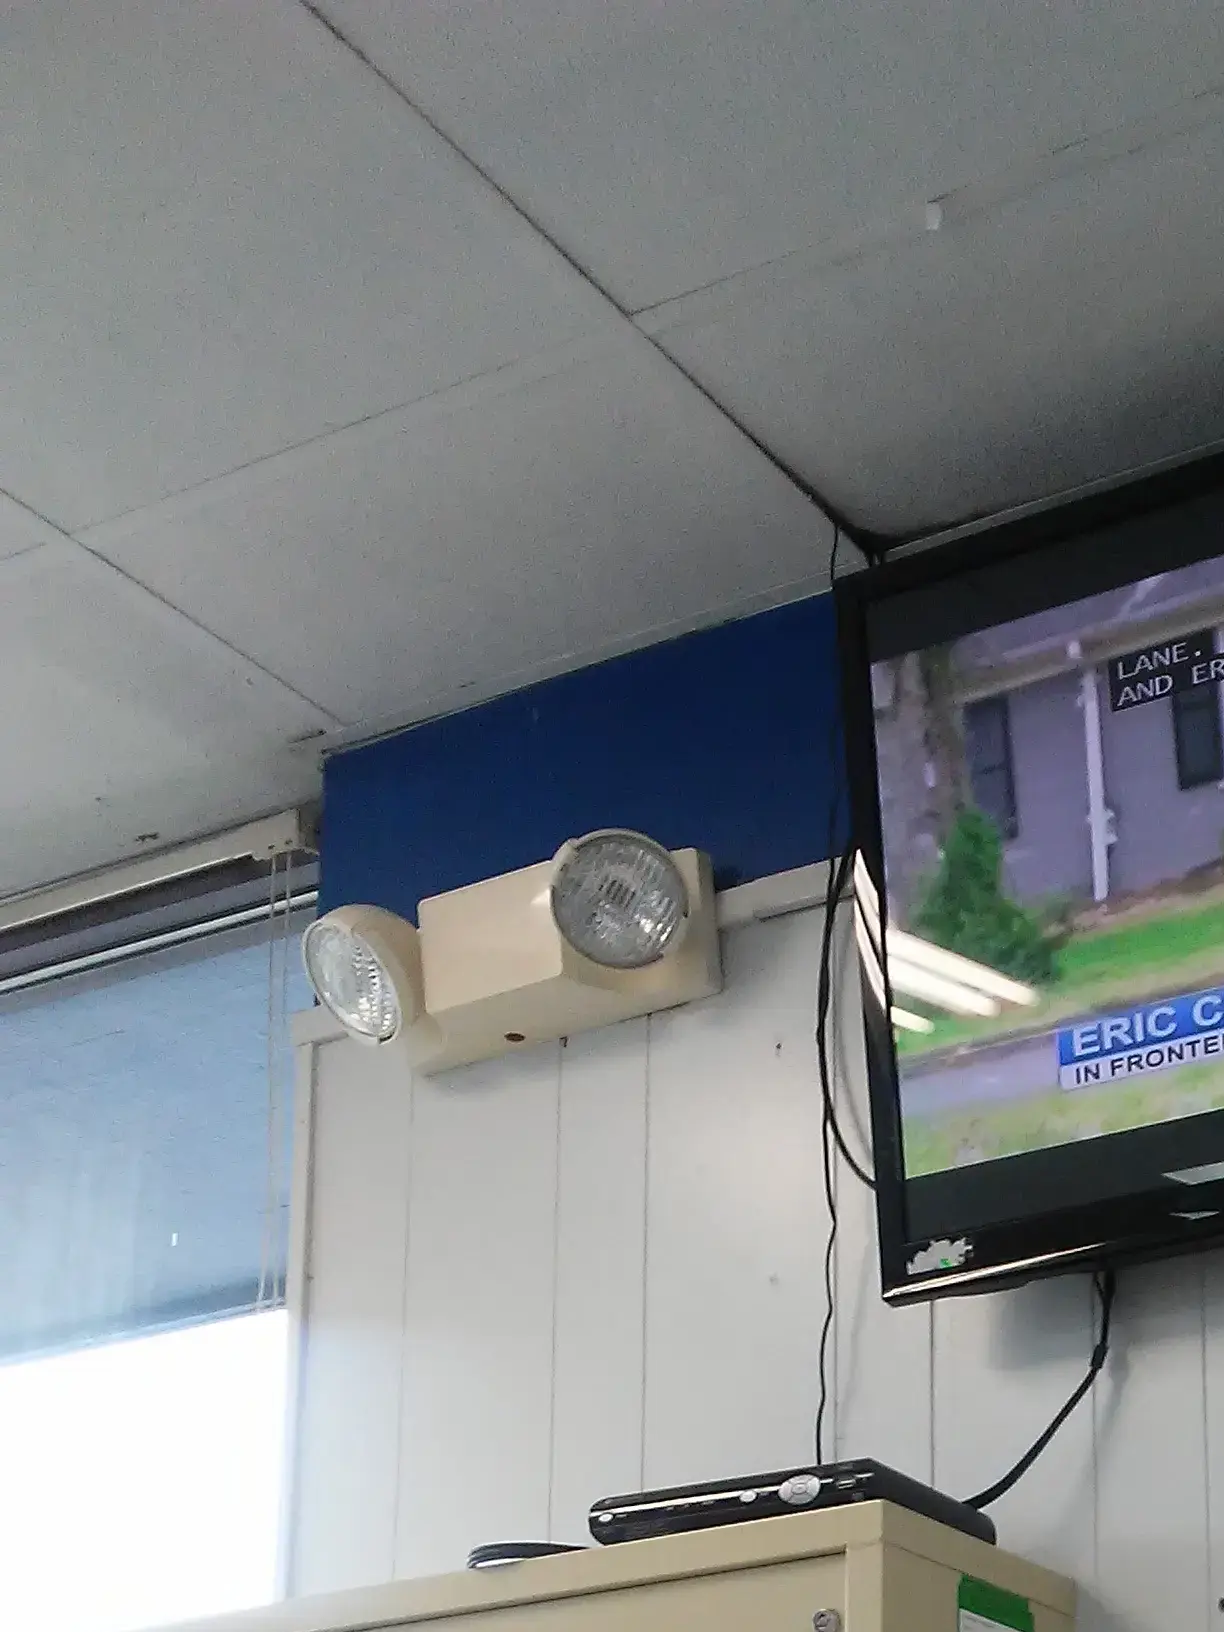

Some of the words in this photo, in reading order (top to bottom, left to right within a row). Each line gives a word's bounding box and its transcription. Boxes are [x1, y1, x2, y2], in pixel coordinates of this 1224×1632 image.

[1117, 641, 1202, 680] LANE.
[1117, 674, 1174, 707] AND
[1072, 1004, 1178, 1057] ERIC
[1075, 1063, 1101, 1085] IN
